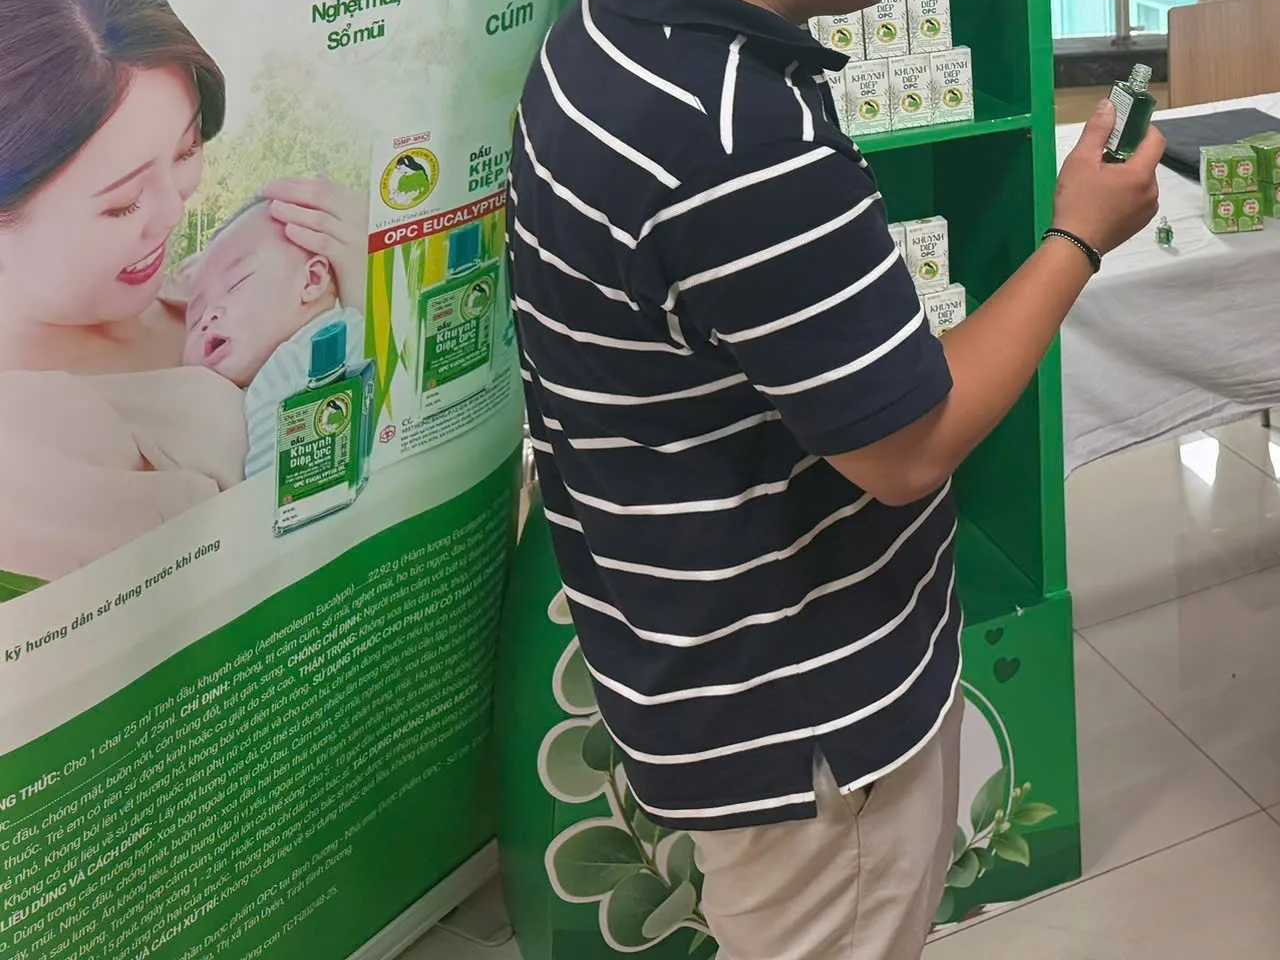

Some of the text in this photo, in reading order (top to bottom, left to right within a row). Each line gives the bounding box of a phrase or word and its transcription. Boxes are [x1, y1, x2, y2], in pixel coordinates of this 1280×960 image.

[327, 20, 385, 51] Sổ mũi
[484, 0, 533, 36] cúm
[469, 150, 512, 177] KHUY
[384, 225, 418, 244] OPC
[290, 435, 332, 458] Khuynh
[314, 447, 331, 461] OPC
[5, 644, 21, 662] kỹ
[26, 625, 68, 653] hướng
[97, 600, 112, 617] sử
[114, 584, 142, 607] dụng
[144, 565, 173, 589] trước
[175, 552, 192, 572] khi
[194, 539, 221, 560] dùng
[180, 694, 199, 717] CHỈ
[201, 681, 230, 704] ĐỊNH:
[19, 771, 60, 800] THỨC:
[63, 756, 86, 775] Cho
[90, 748, 94, 759] 1
[100, 734, 121, 754] chai
[123, 721, 136, 738] 25
[139, 710, 151, 728] ml
[176, 685, 194, 702] dầu
[197, 662, 231, 689] khuynh
[12, 825, 39, 845] đầu,
[41, 801, 77, 828] chóng
[80, 784, 104, 805] mặt,
[106, 765, 131, 788] buồn
[175, 717, 200, 739] trùng
[4, 843, 41, 870] thuốc.
[45, 825, 64, 844] Trẻ
[66, 815, 84, 833] em
[87, 805, 100, 819] có
[15, 861, 40, 884] nhỏ.
[44, 837, 80, 866] Không
[83, 824, 99, 841] bôi
[4, 843, 99, 910] Không có dữ liệu
